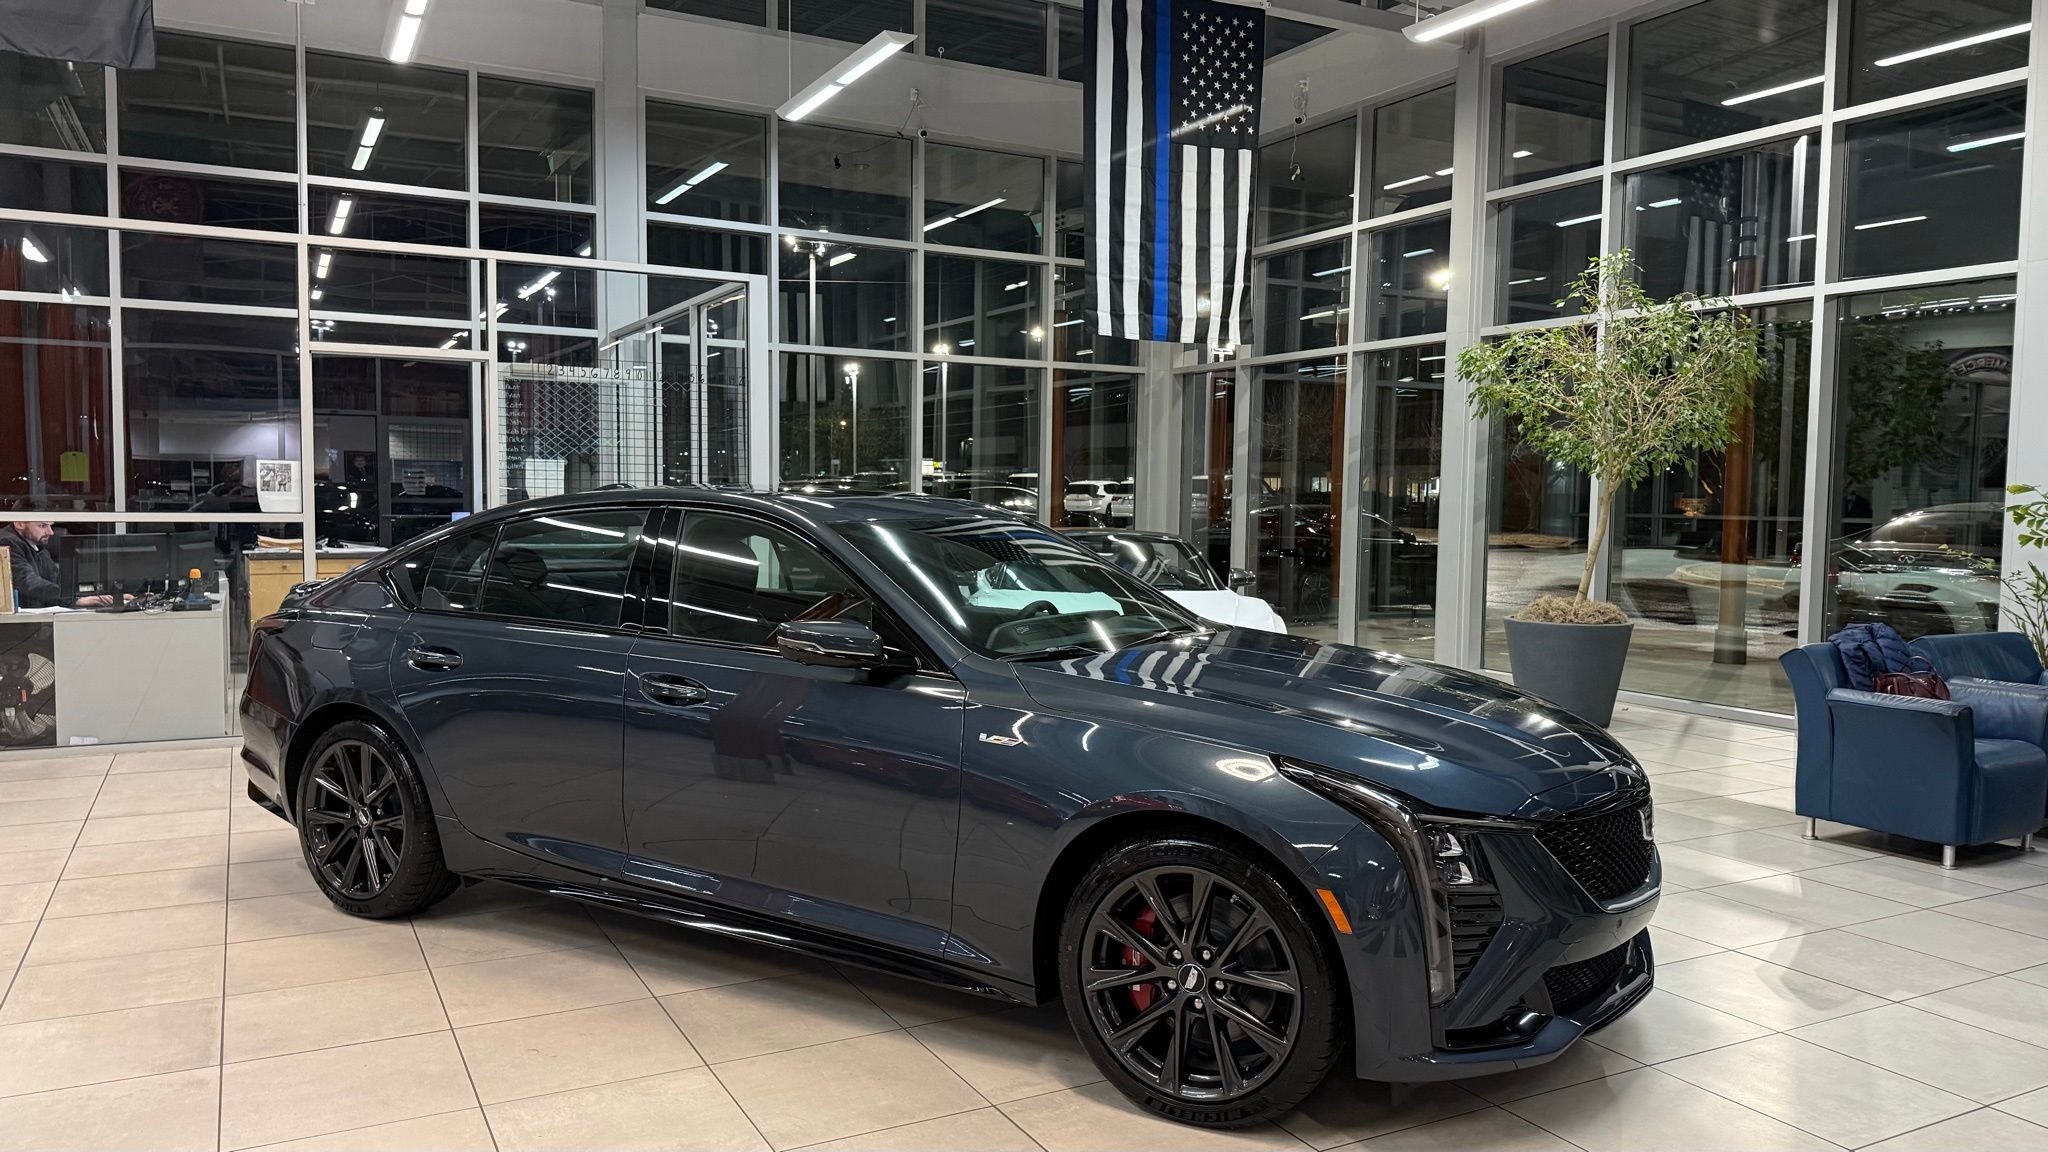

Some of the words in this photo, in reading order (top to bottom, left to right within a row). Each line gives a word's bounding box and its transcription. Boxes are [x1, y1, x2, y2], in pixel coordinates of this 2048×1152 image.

[547, 364, 555, 375] 2
[558, 365, 565, 376] 3
[569, 365, 575, 377] 4
[581, 368, 587, 377] 5
[590, 367, 599, 379] 6
[603, 368, 610, 379] 7
[613, 369, 620, 379] 8
[625, 368, 631, 380] 9
[635, 369, 643, 381] 10
